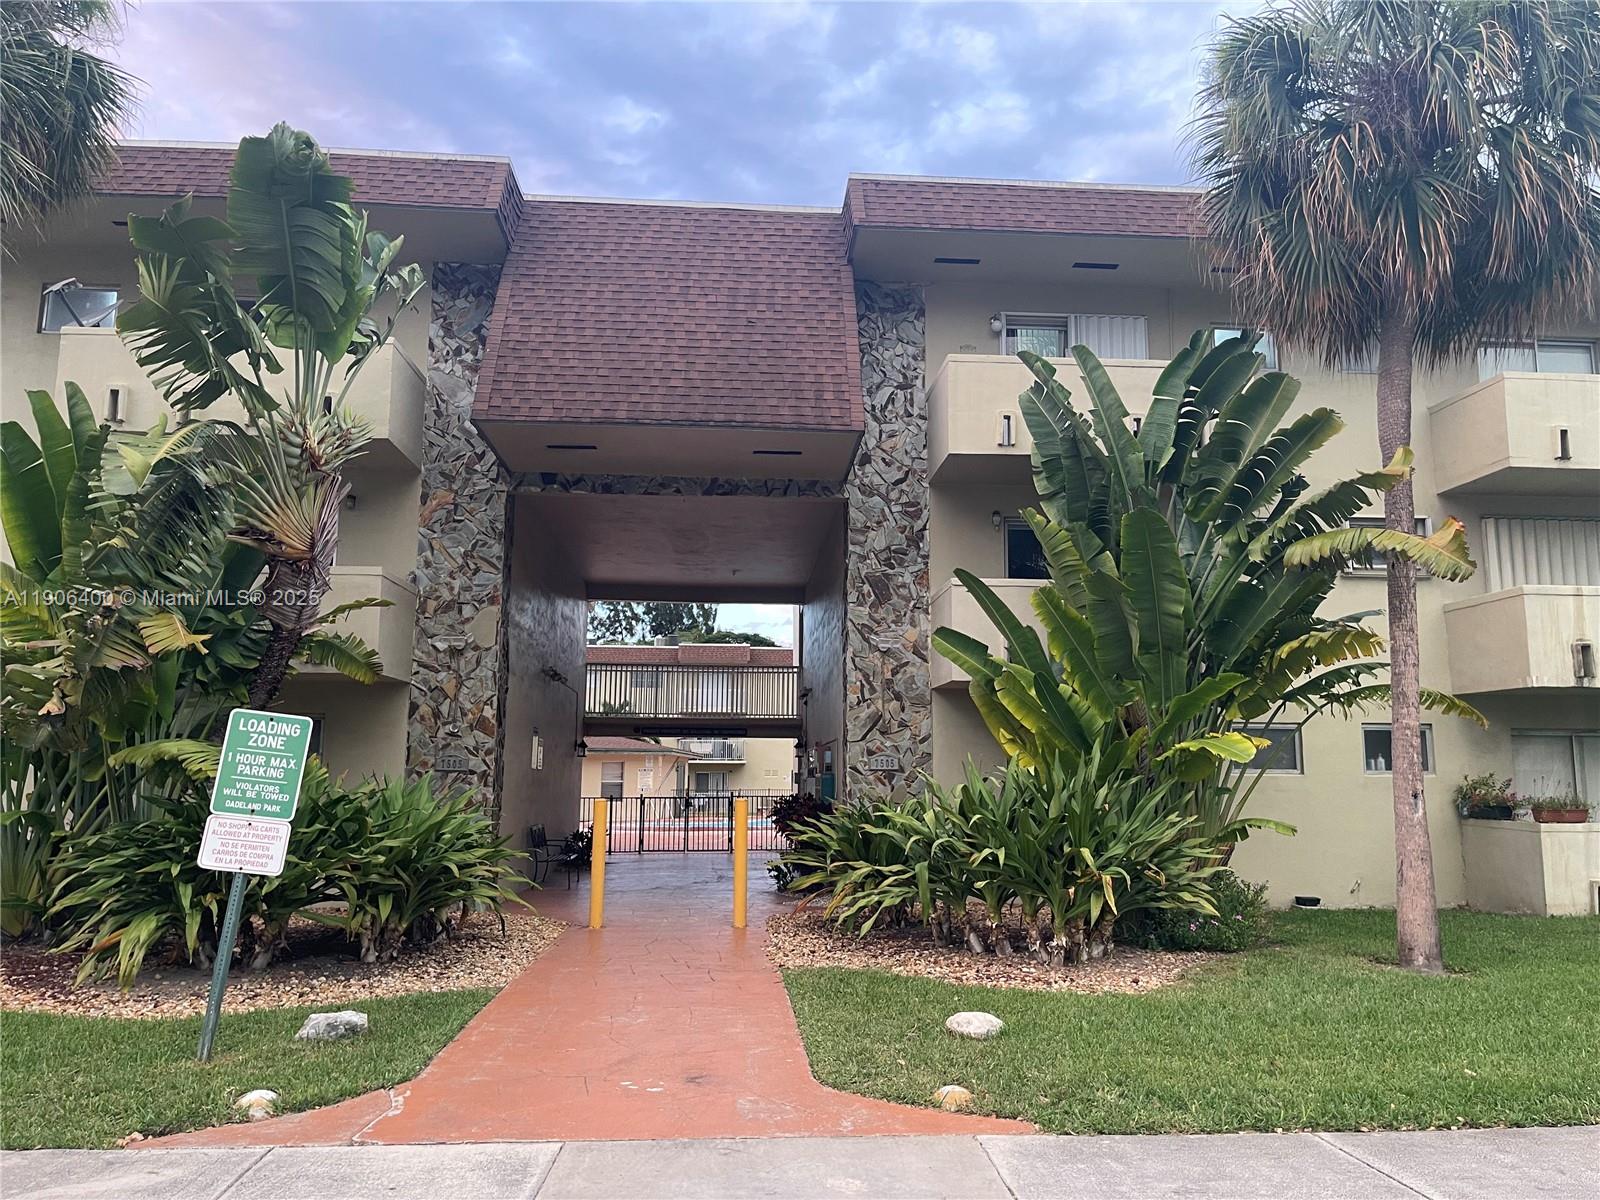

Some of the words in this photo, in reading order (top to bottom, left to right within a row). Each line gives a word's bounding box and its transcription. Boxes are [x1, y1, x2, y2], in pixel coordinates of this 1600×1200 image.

[239, 718, 301, 737] LOADING
[247, 733, 287, 750] ZONE
[228, 752, 233, 762] 1
[236, 753, 266, 766] HOUR
[270, 756, 298, 770] MAX.
[237, 764, 285, 779] PARKING
[235, 781, 280, 793] VIOLATORS
[223, 787, 242, 797] WILL
[246, 790, 257, 798] BE
[261, 791, 289, 802] TOWED
[225, 799, 262, 811] DADELAND
[263, 803, 281, 812] PARK
[228, 823, 259, 832] SHOPPING
[260, 825, 280, 834] CARTS
[211, 829, 242, 838] ALLOWED
[251, 833, 283, 842] PROPERTY
[219, 841, 229, 849] NO
[240, 843, 271, 853] PERMITEN
[212, 848, 238, 858] CARROS
[248, 852, 274, 861] COMPRA
[214, 856, 223, 864] EN
[224, 857, 233, 865] LA
[233, 858, 269, 869] PROPIEDAD
